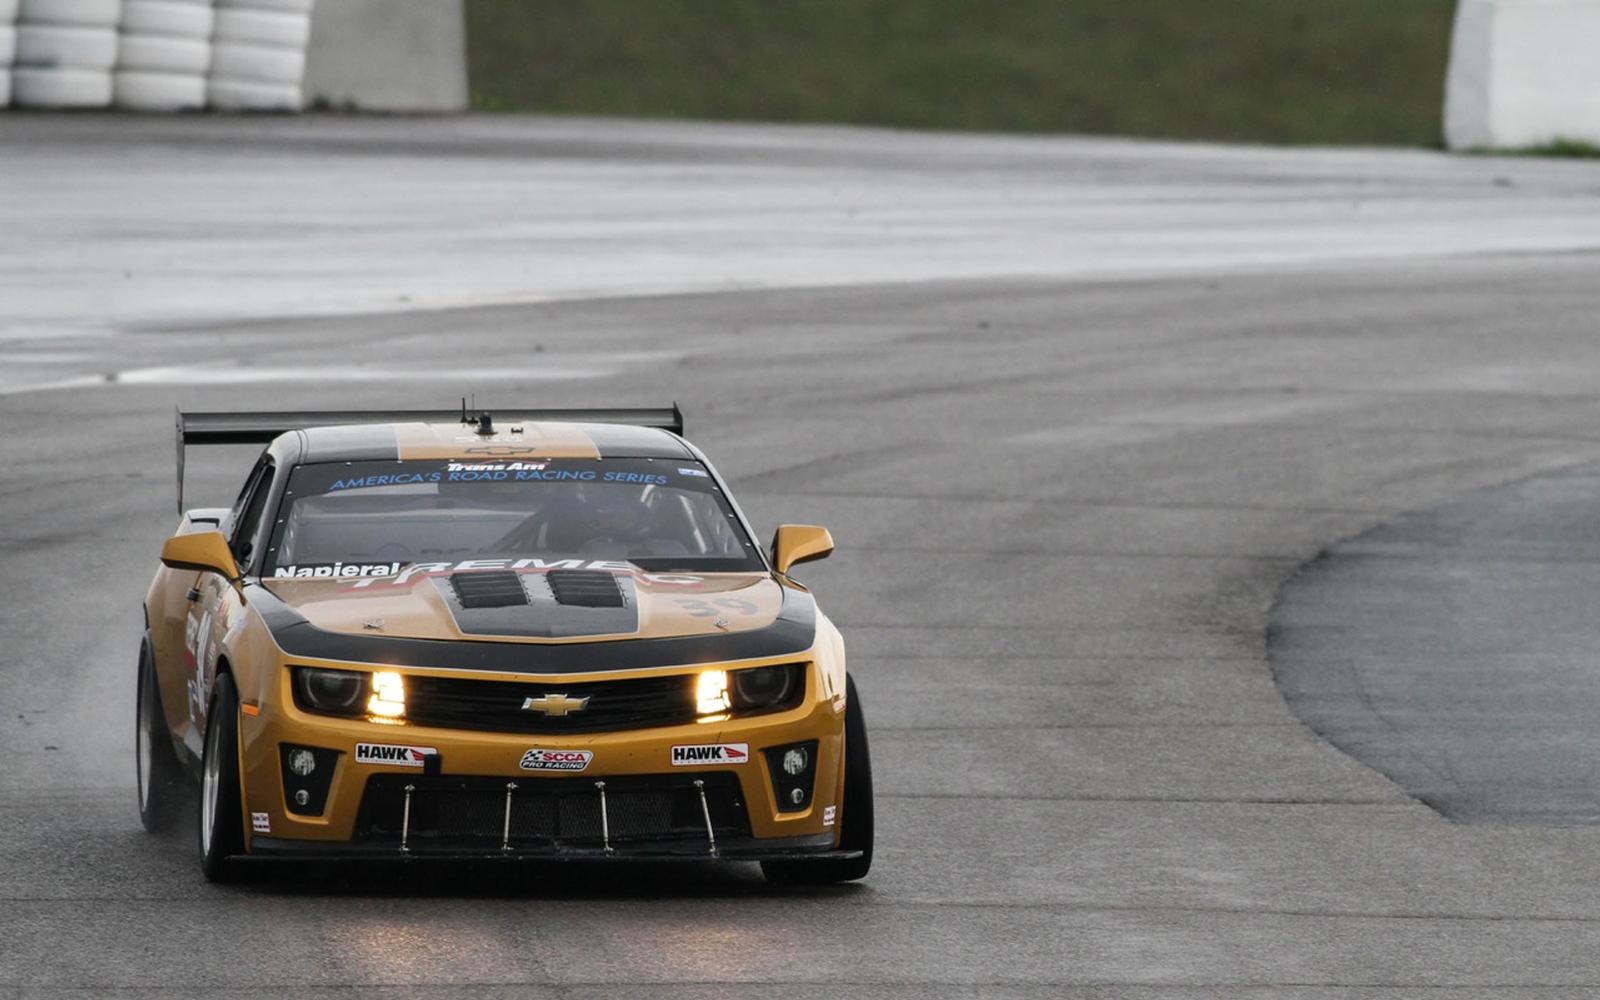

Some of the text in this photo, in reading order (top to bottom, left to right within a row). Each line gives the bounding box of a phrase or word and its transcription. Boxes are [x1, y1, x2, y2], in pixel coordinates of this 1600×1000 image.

[447, 462, 546, 472] Trans Am
[330, 471, 441, 490] AMERICA'S
[448, 470, 508, 481] ROAD
[515, 470, 597, 481] RACING
[603, 470, 668, 485] SERIES
[273, 562, 400, 578] Napieral
[357, 745, 409, 761] HAWK
[543, 752, 586, 762] SCCA
[673, 746, 722, 760] HAWK
